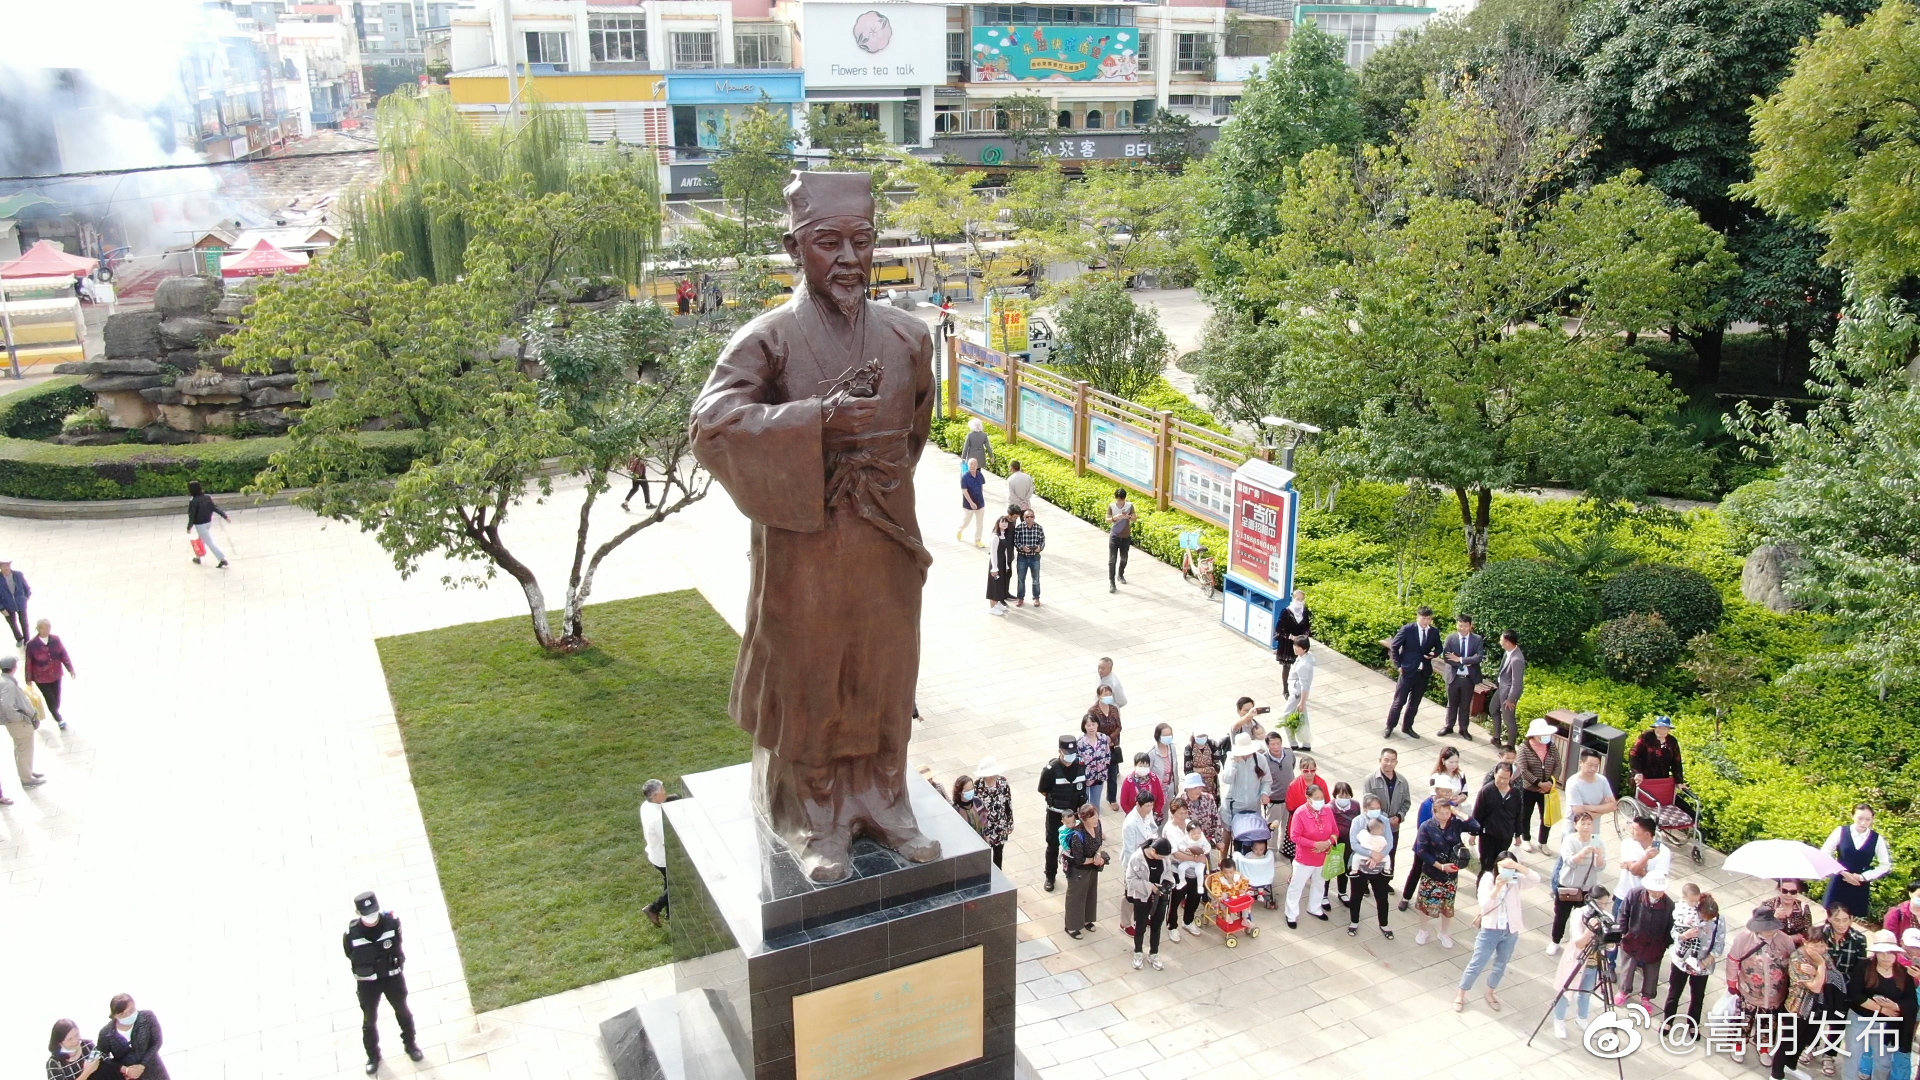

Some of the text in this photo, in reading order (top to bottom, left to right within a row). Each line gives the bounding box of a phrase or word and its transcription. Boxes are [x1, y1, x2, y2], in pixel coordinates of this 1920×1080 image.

[831, 64, 915, 76] Flowers tea talk
[1242, 499, 1277, 528] 广告位
